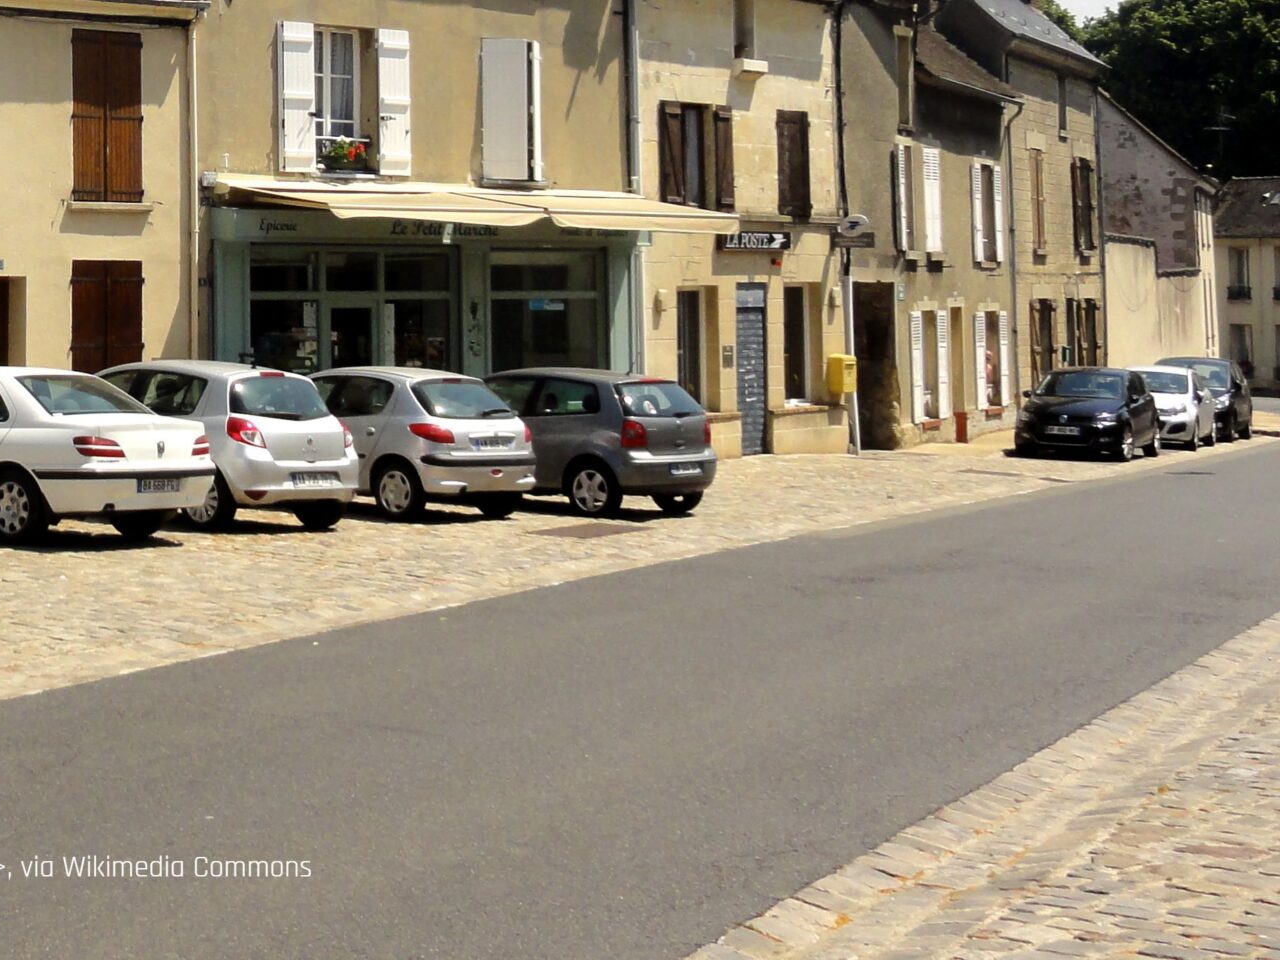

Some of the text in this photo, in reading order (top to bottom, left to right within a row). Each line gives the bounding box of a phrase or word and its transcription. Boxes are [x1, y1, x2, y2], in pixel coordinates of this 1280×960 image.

[390, 219, 408, 236] Le
[412, 219, 444, 237] Petit
[725, 232, 770, 249] LA POSTE
